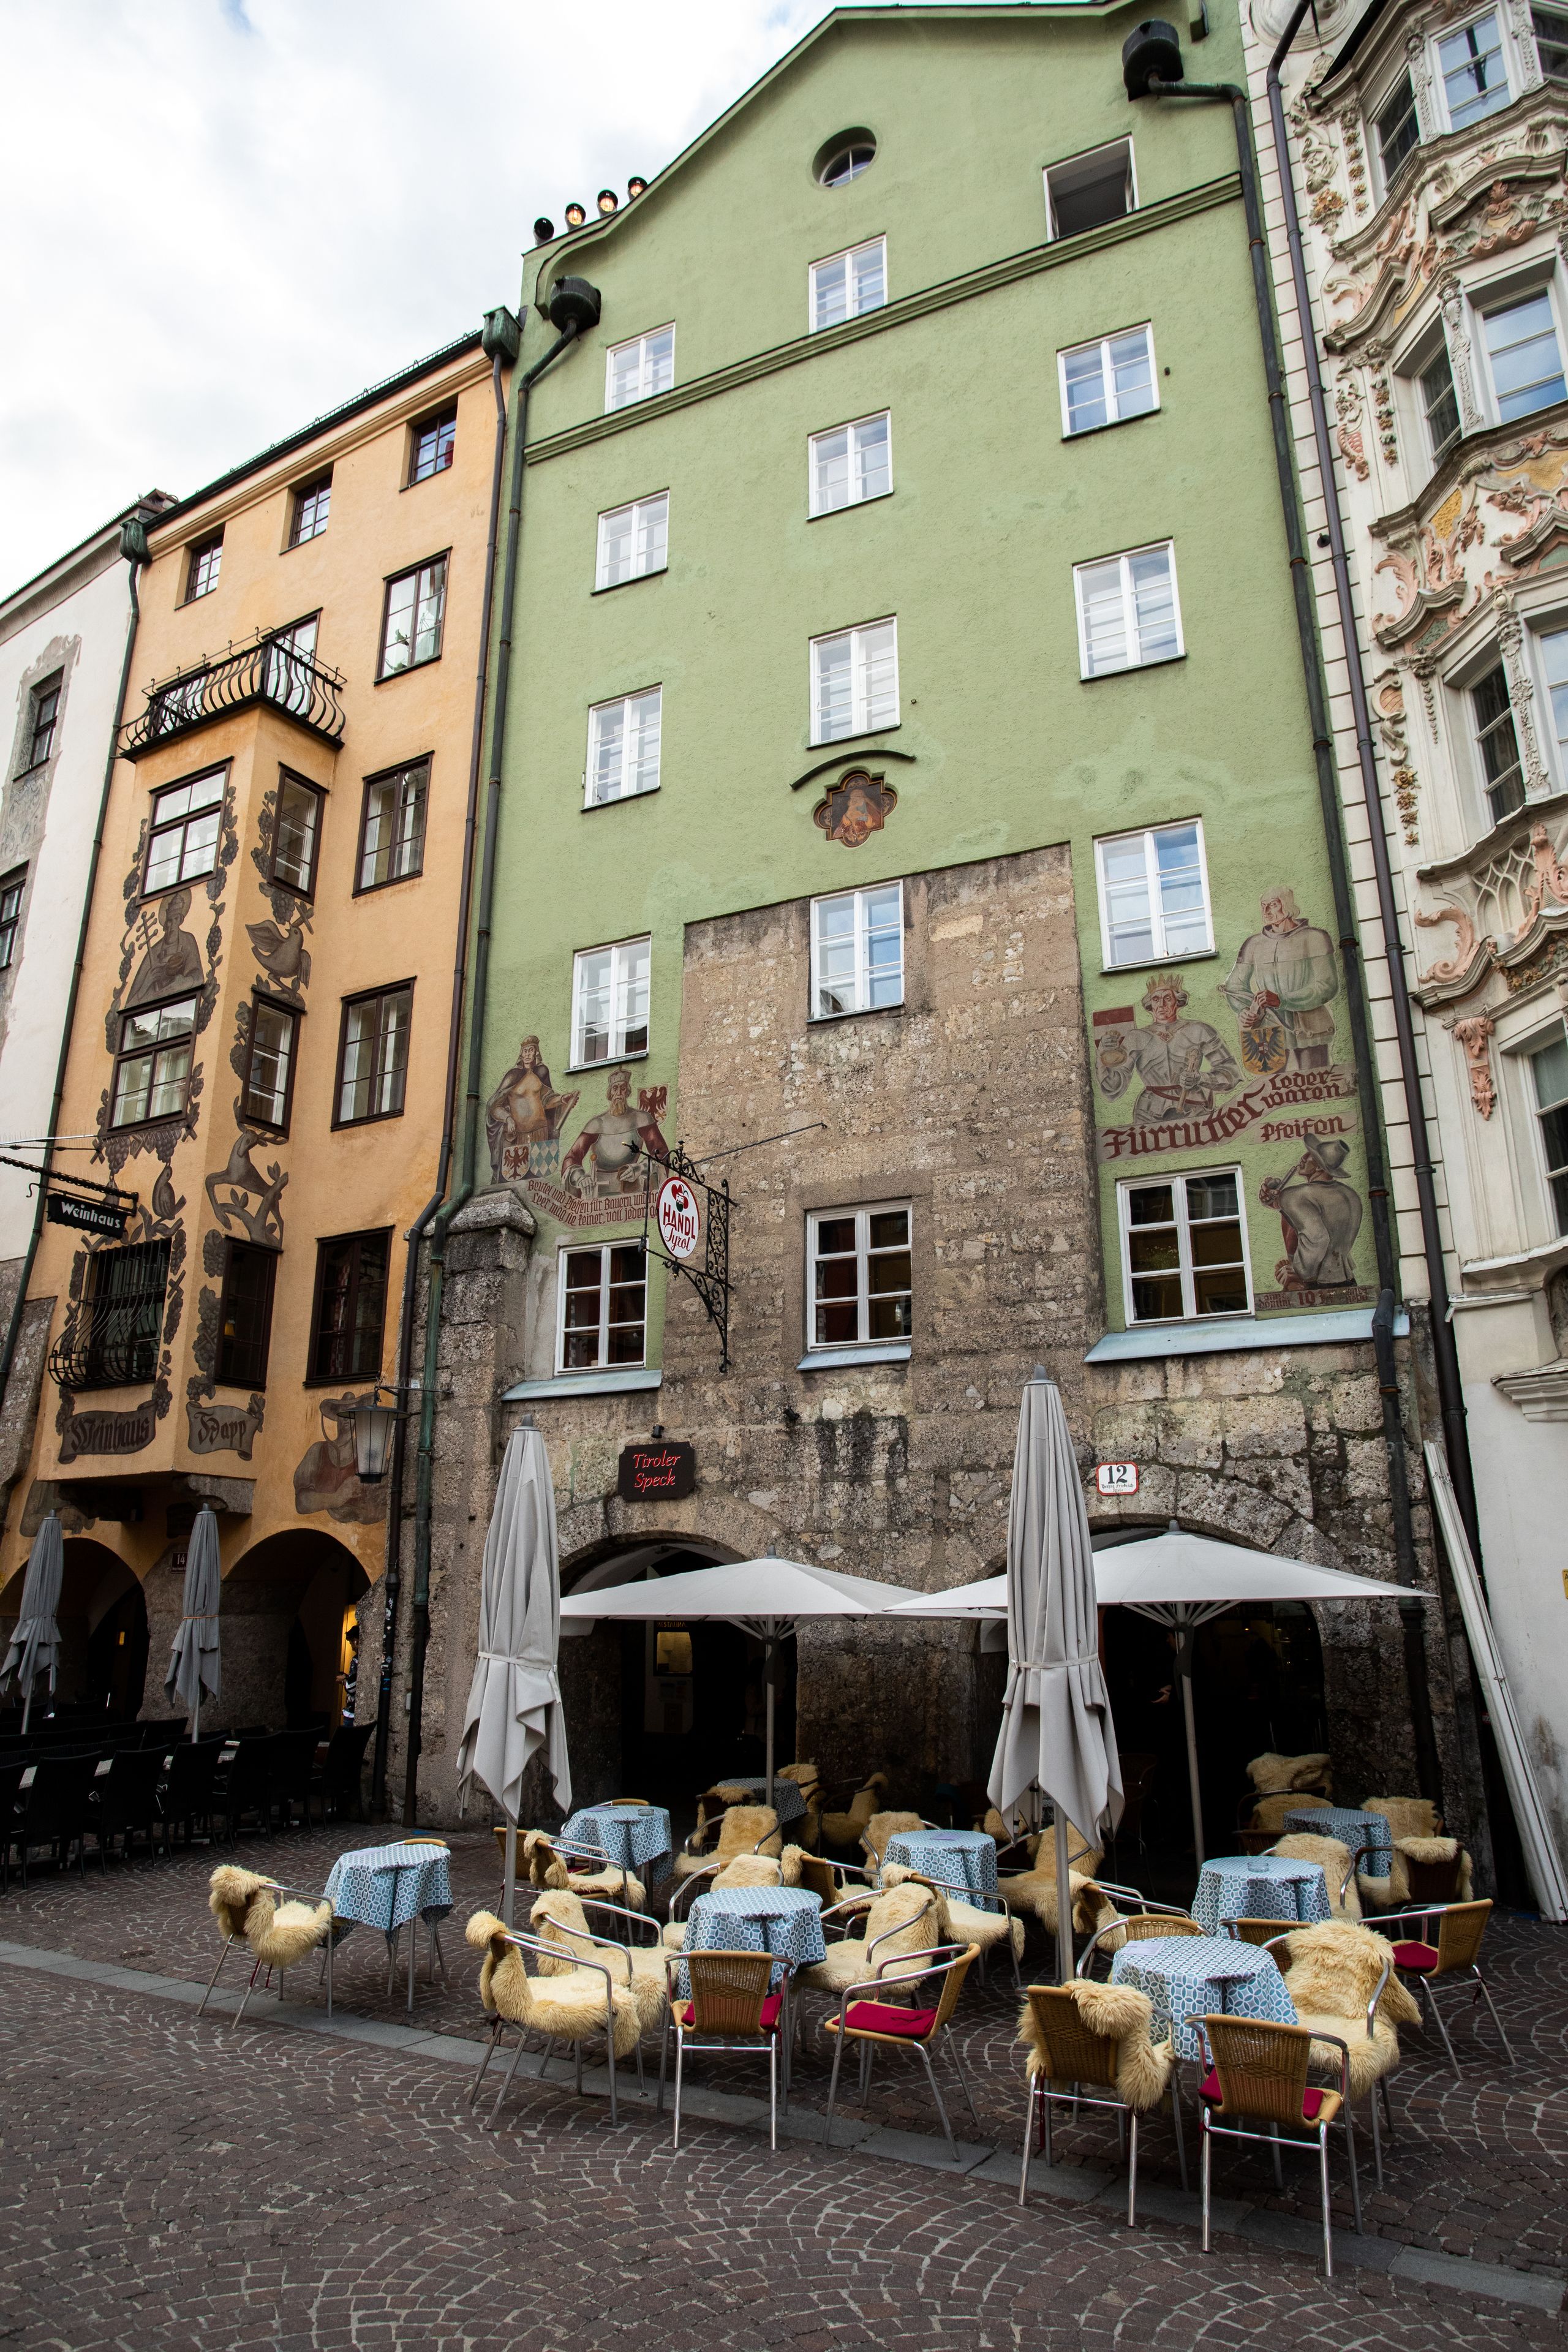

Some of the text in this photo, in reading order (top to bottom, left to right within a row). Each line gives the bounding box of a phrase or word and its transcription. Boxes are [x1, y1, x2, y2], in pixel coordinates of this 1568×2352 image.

[1260, 1082, 1341, 1109] waren
[1259, 1116, 1357, 1143] Pfeifen
[527, 1180, 552, 1195] Beutel
[552, 1188, 567, 1205] und
[603, 1195, 631, 1209] Bauern
[61, 1201, 121, 1229] Weinhaus
[548, 1203, 567, 1222] mag
[606, 1207, 623, 1223] voll
[663, 1202, 696, 1240] HANDL
[664, 1223, 690, 1251] Tyrol
[67, 1411, 246, 1452] Weinhaus Happ
[633, 1449, 681, 1469] Tiroler
[633, 1468, 676, 1493] Speck
[1107, 1464, 1128, 1483] 12
[177, 1553, 186, 1565] 14
